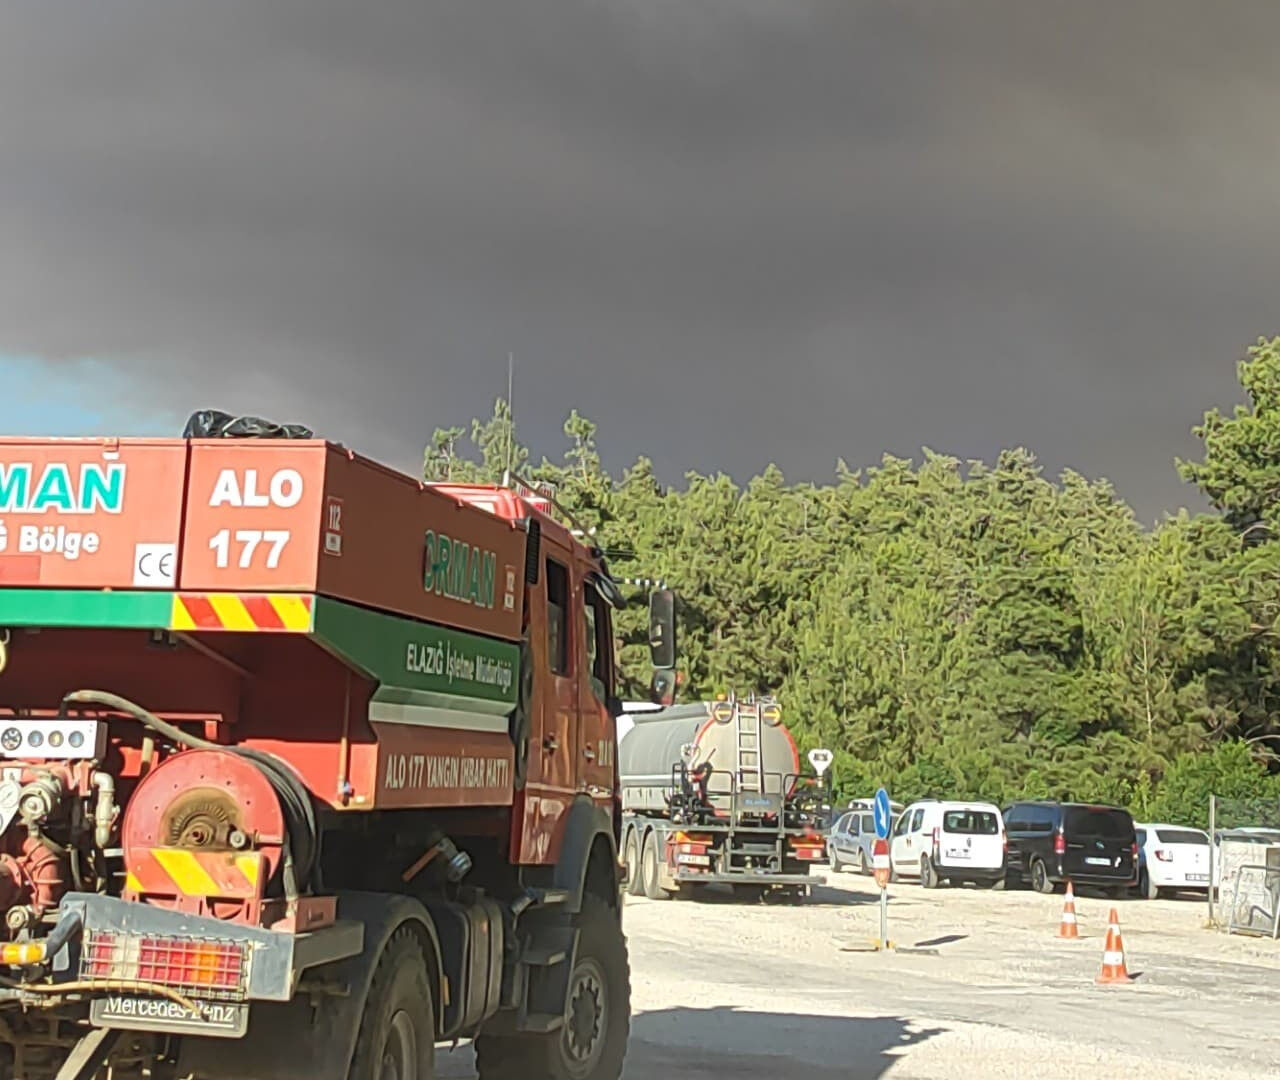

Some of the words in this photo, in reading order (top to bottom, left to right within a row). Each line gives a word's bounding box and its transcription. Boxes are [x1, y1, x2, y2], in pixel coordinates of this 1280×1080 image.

[207, 468, 304, 509] ALO
[18, 524, 100, 561] Bölge
[208, 528, 291, 569] 177
[138, 552, 173, 578] CE
[424, 528, 497, 610] ORMAN
[406, 640, 445, 676] ELAZIĞ
[384, 754, 406, 789] ALO
[408, 755, 425, 789] 177
[426, 756, 460, 789] YANGIN
[485, 758, 509, 789] HATTI
